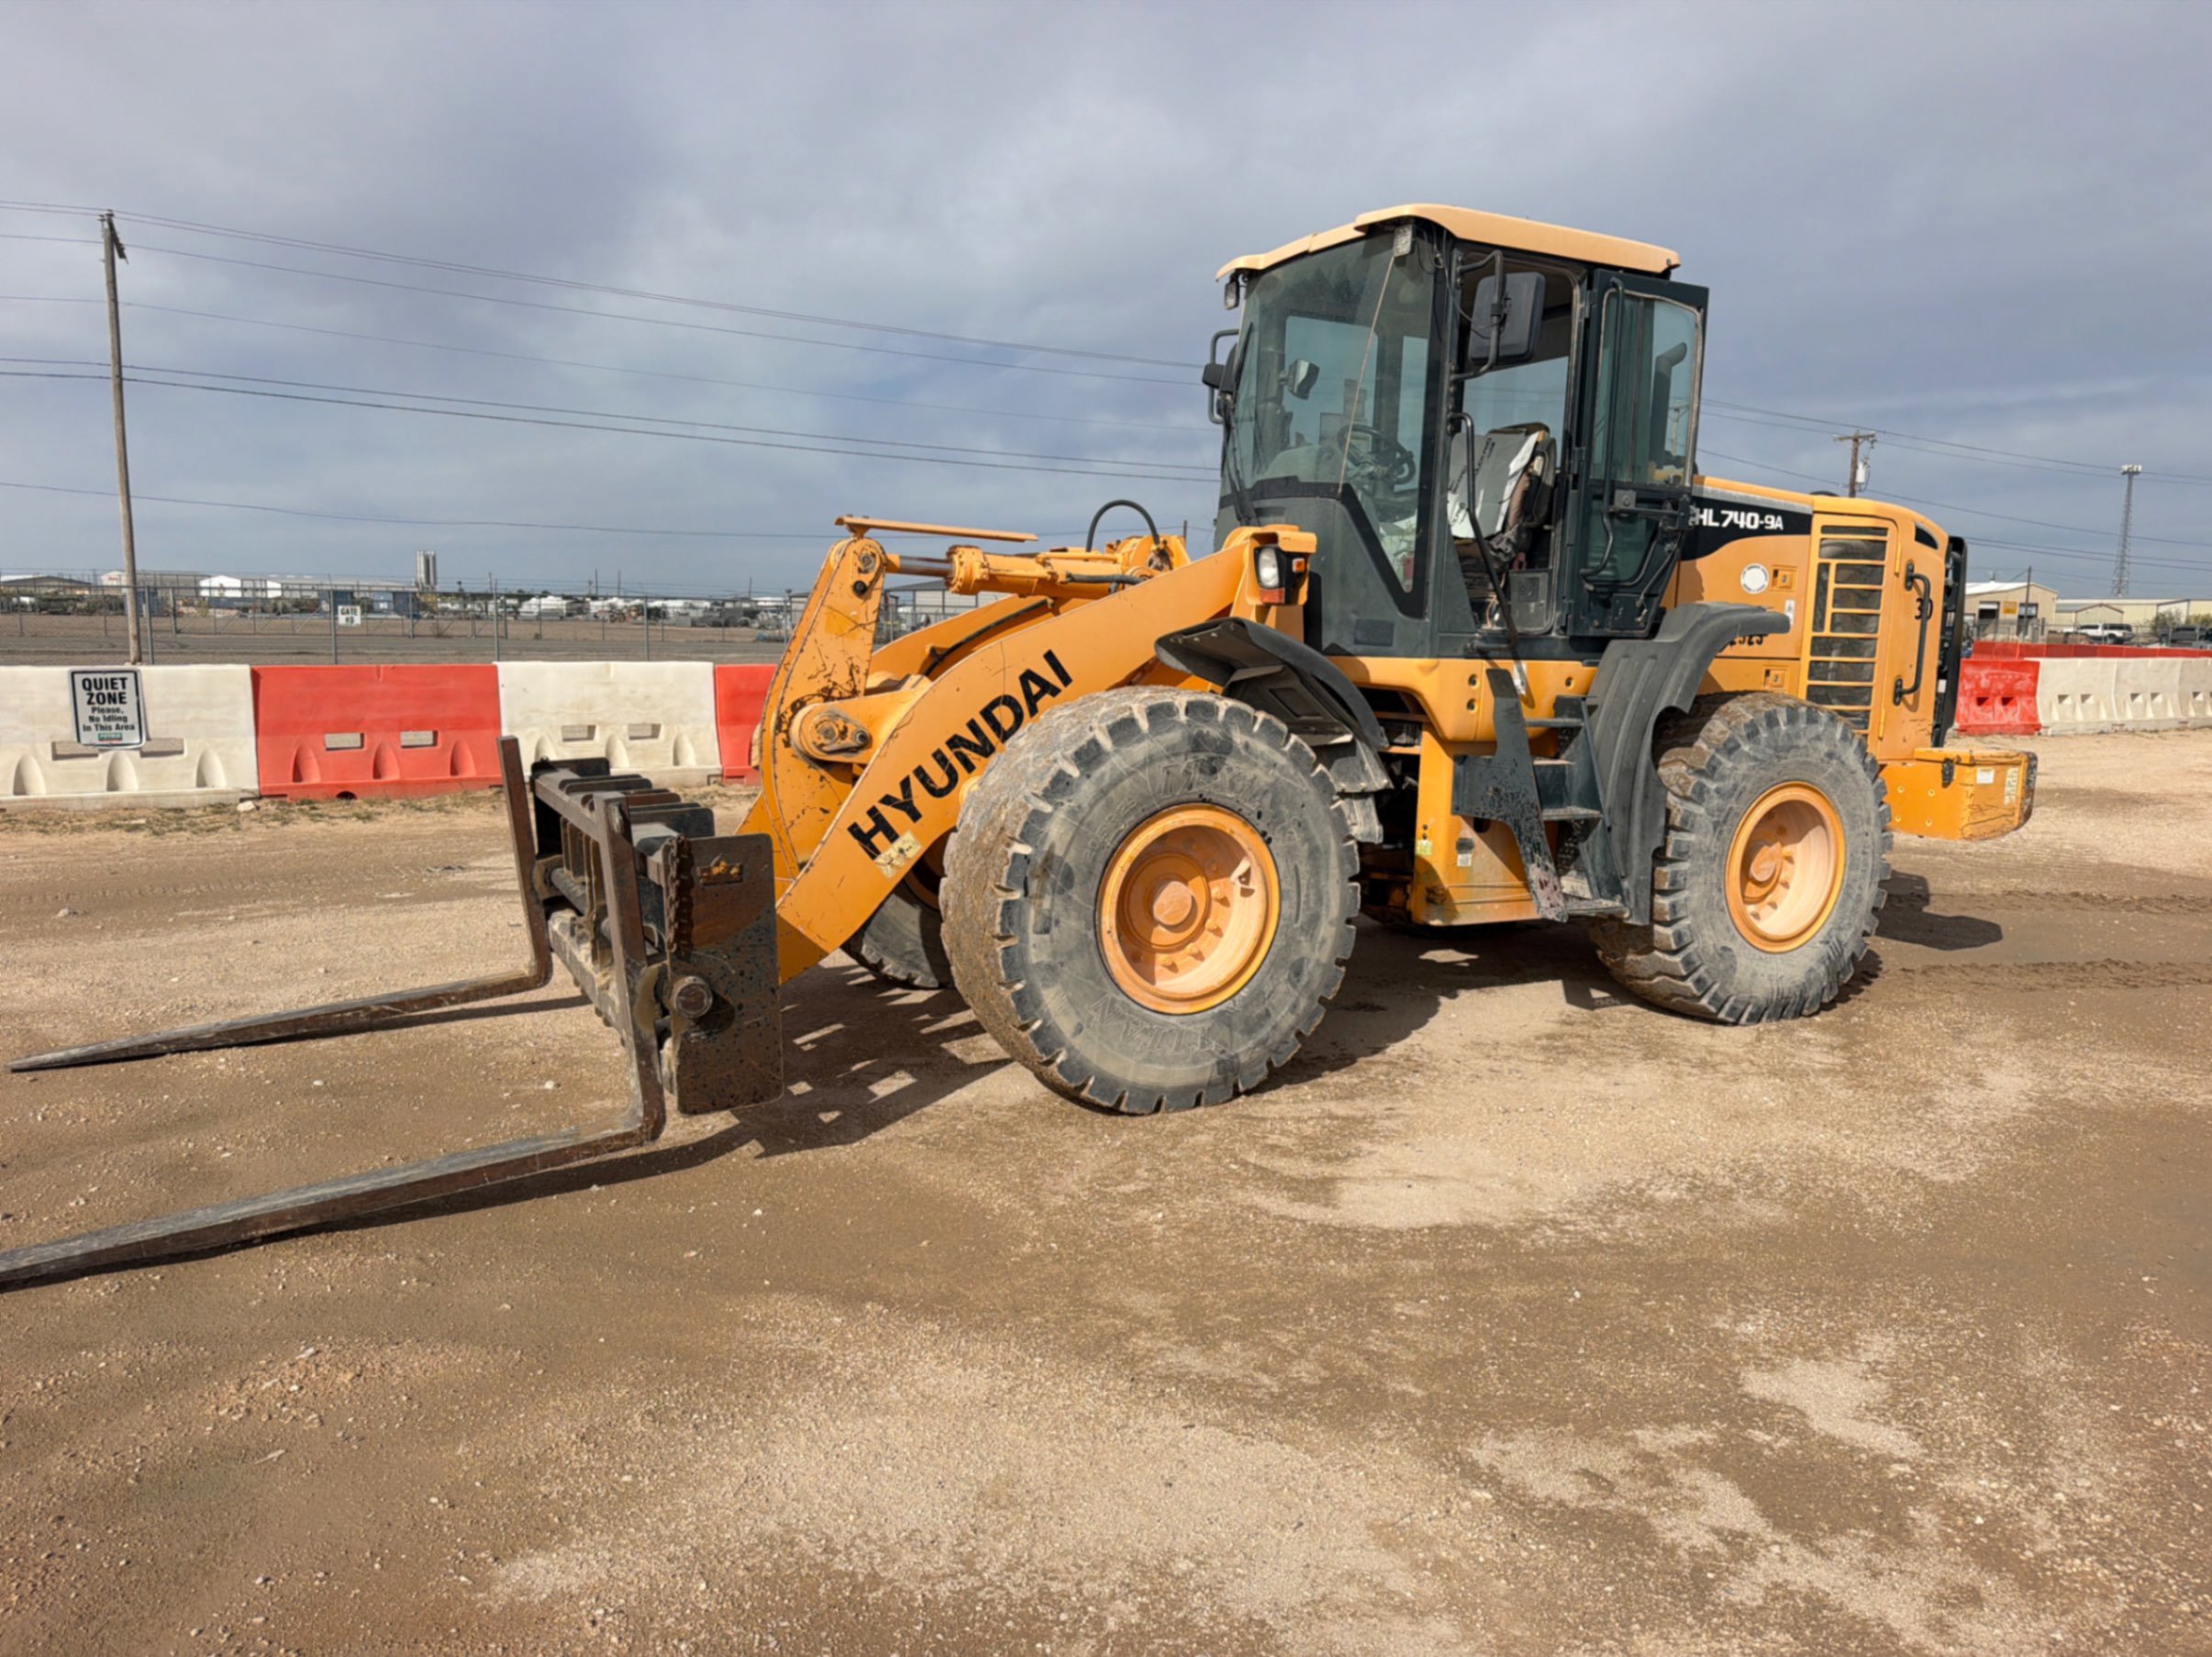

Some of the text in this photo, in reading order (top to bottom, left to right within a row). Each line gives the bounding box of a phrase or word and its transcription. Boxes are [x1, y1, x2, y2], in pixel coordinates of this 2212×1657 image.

[82, 677, 128, 691] QUIET
[86, 692, 127, 705] ZONE
[103, 715, 128, 723] Idling
[83, 724, 92, 732] In
[94, 723, 113, 732] This
[847, 649, 1073, 861] HYUNDAI
